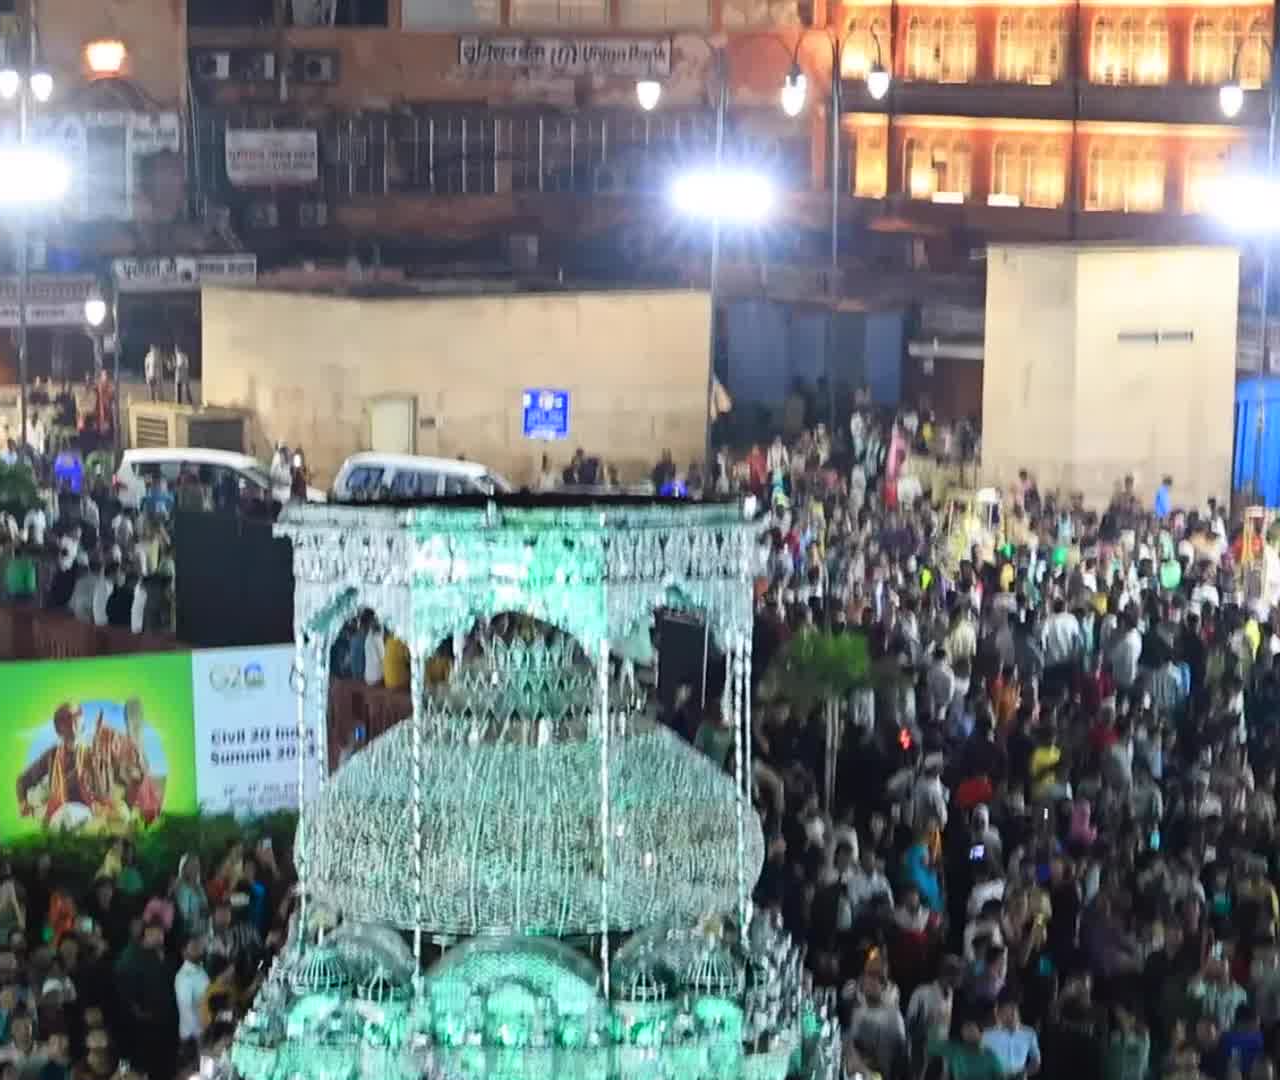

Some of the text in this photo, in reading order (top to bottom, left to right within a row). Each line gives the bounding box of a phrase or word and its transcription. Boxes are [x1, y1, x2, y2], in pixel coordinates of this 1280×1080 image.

[211, 725, 315, 746] Civil 20 Inda
[210, 747, 272, 766] Summit
